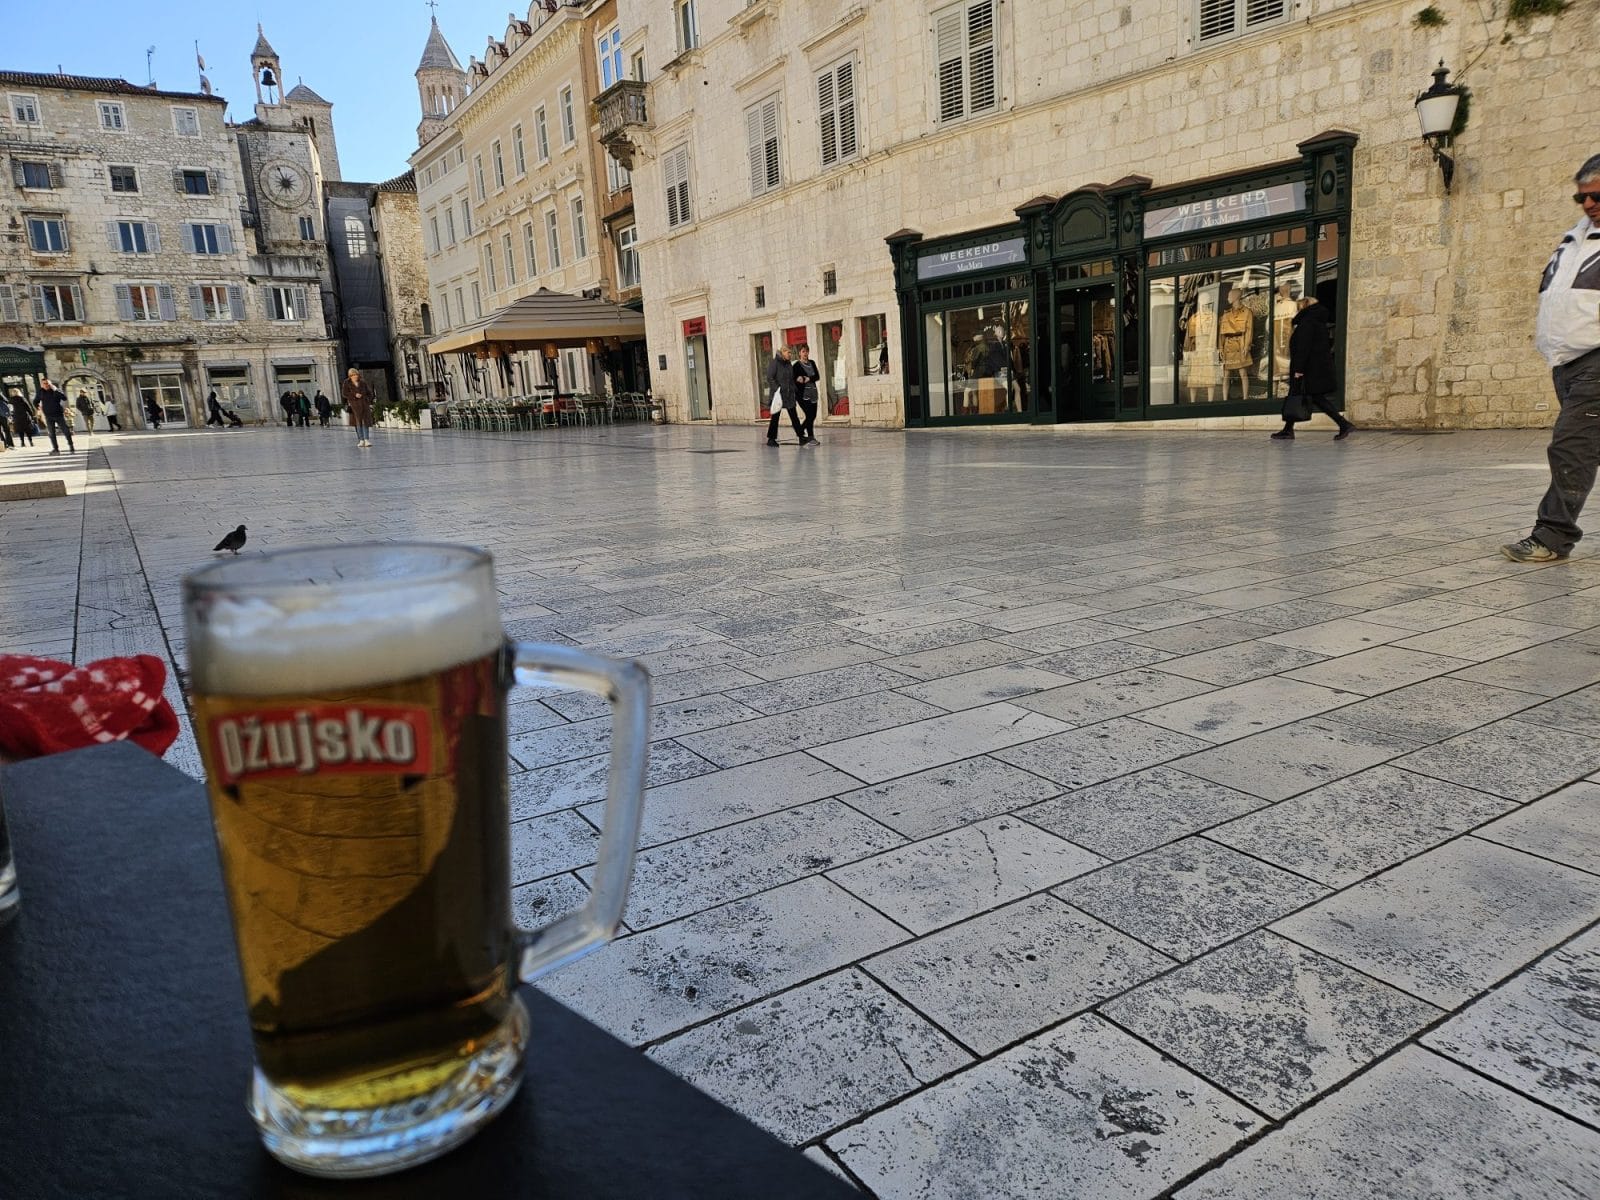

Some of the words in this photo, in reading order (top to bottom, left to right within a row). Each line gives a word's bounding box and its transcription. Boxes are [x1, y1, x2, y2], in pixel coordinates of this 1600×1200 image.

[1178, 190, 1266, 217] WEEKEND
[940, 243, 1000, 262] WEEKEND
[219, 710, 415, 776] Ožujsko
